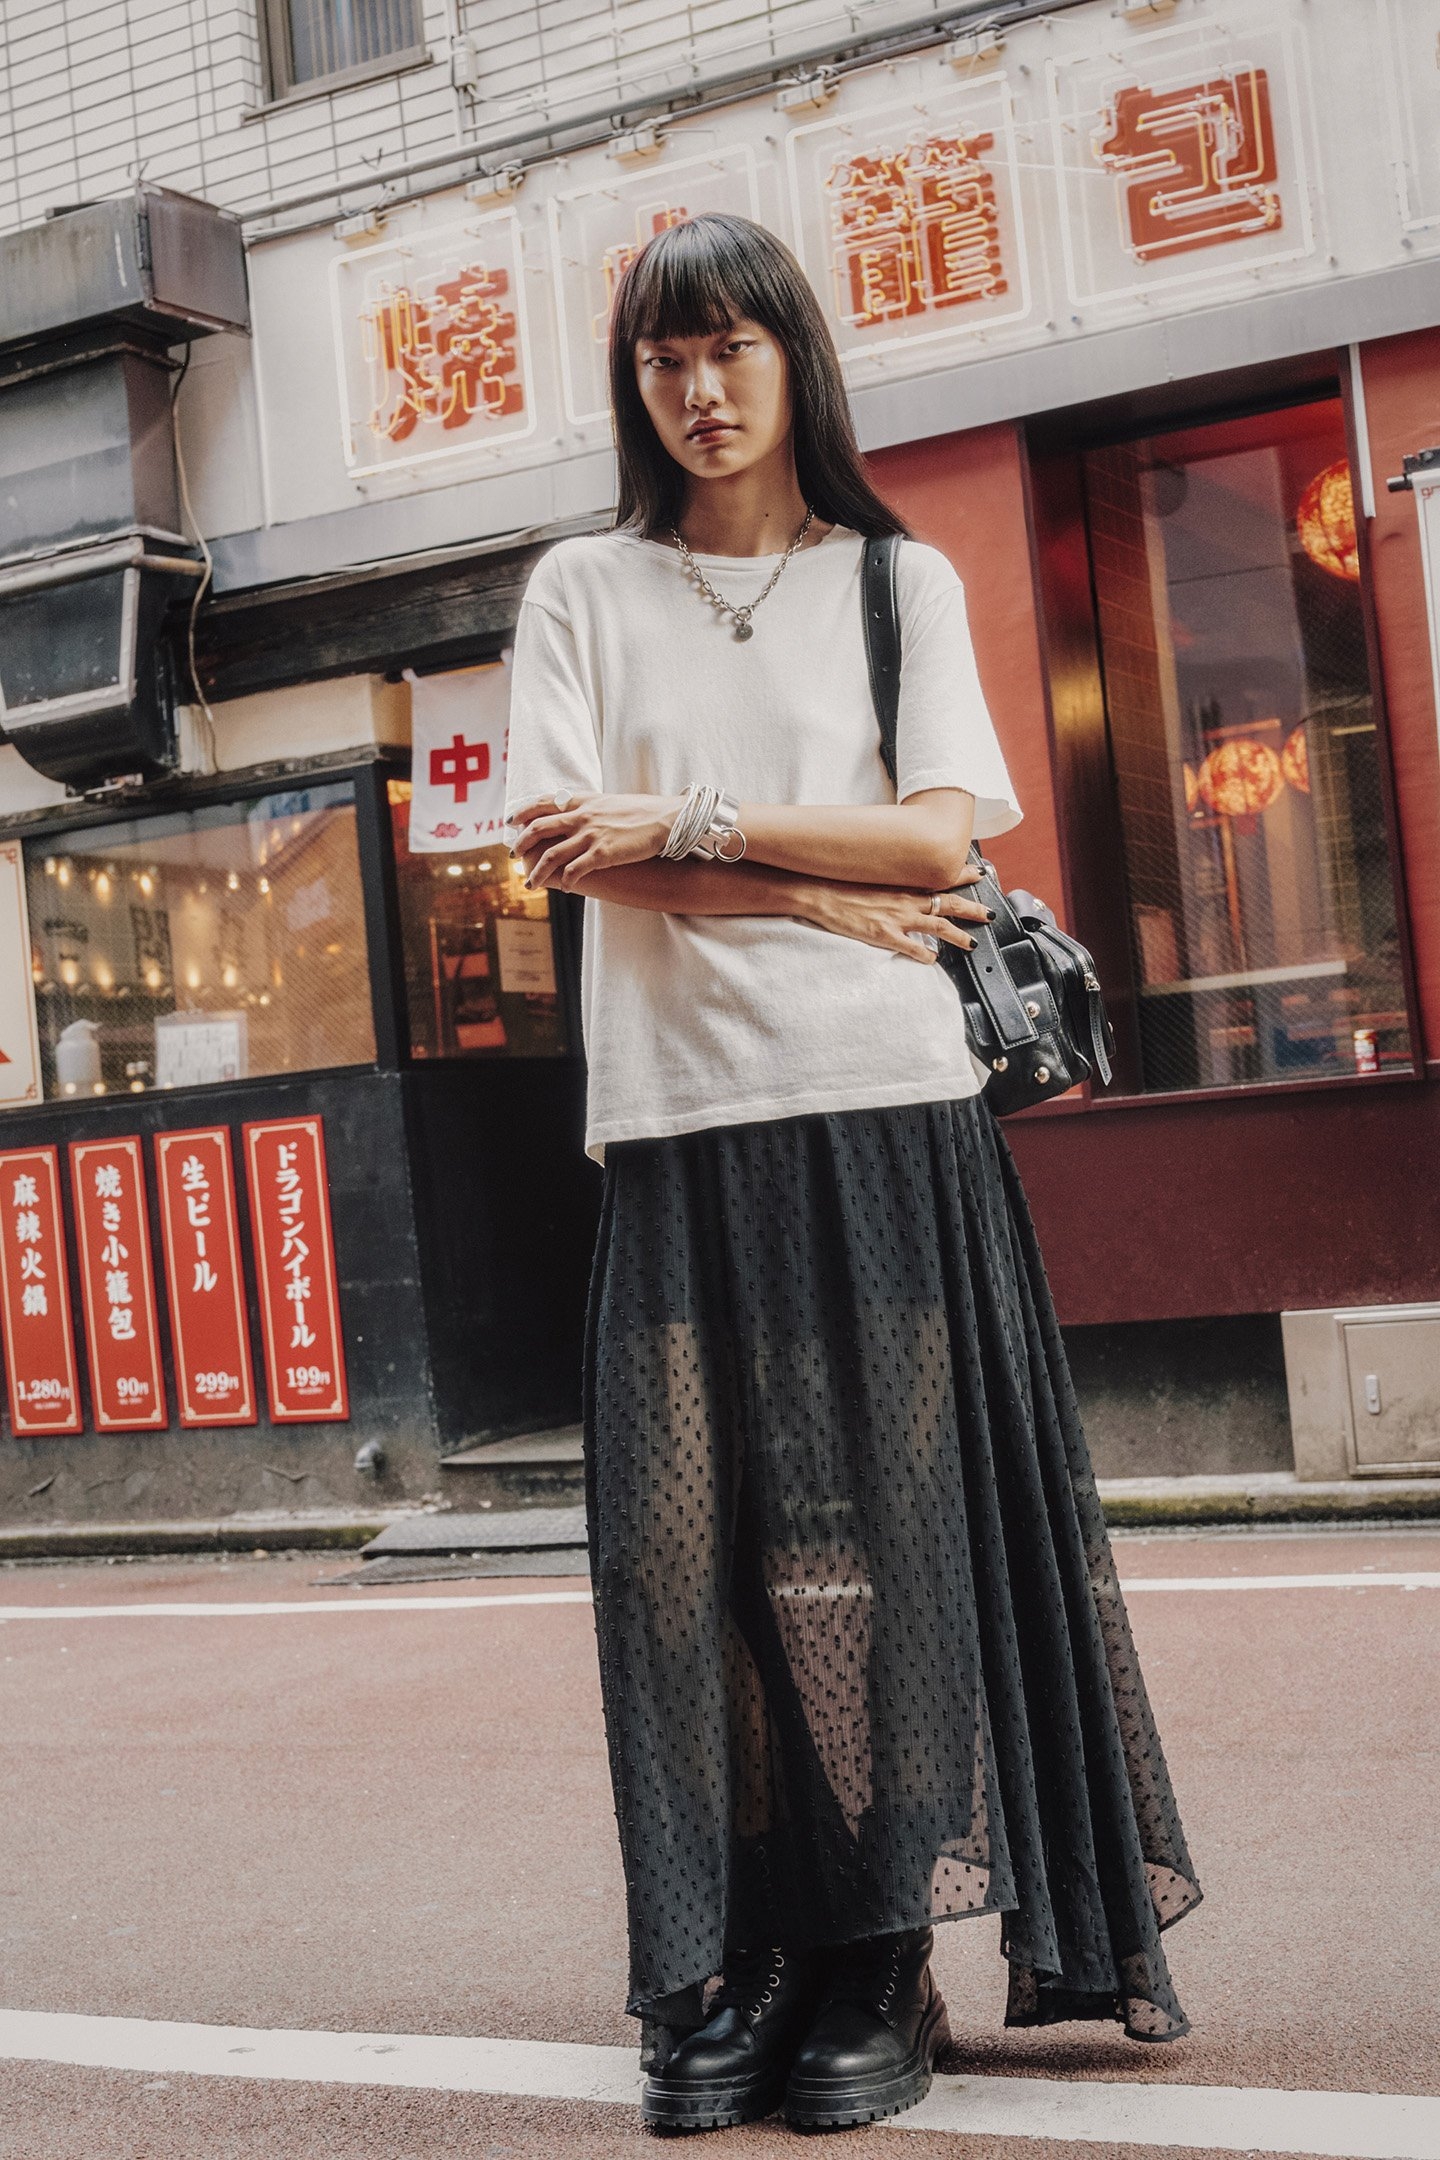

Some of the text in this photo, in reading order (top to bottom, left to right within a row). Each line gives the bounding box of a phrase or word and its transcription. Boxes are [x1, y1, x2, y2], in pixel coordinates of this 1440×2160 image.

[429, 727, 510, 803] 中
[12, 1173, 48, 1317] 麻辣火鍋
[95, 1163, 136, 1340] 焼き小籠包
[181, 1154, 218, 1293] 生ビール
[275, 1141, 316, 1349] ドラゴンハイボール
[17, 1377, 71, 1403] 1,280円
[116, 1376, 149, 1398] 90円
[194, 1370, 240, 1394] 299円
[285, 1365, 331, 1389] 199円
